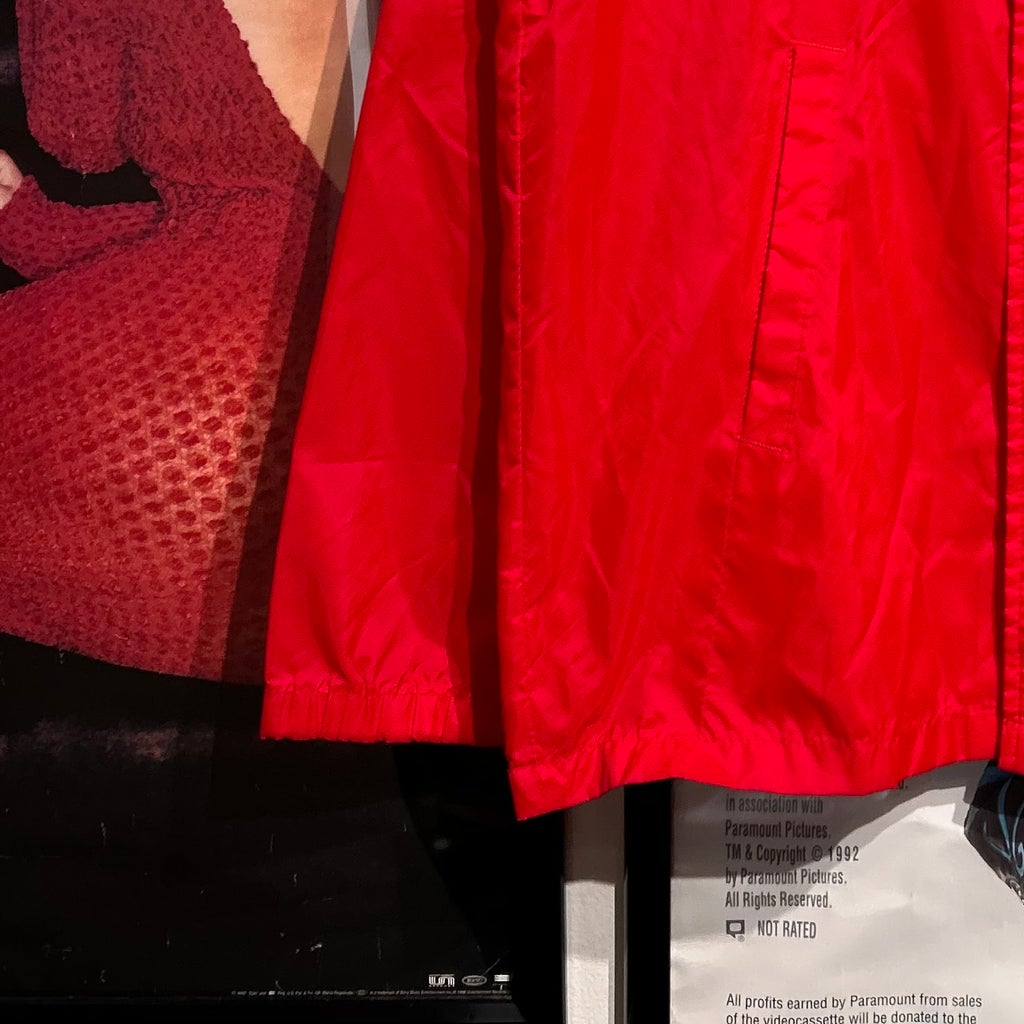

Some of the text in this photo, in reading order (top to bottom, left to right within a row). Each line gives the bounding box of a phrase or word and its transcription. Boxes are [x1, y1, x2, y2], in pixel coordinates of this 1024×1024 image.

[725, 794, 824, 814] in association with
[725, 819, 832, 839] Paramount Pictures.
[725, 843, 742, 860] TM
[745, 844, 753, 861] &
[756, 844, 806, 866] Copyright
[828, 845, 860, 861] 1992
[725, 867, 848, 888] by Paramount Pictures.
[725, 891, 833, 910] All Rights Reserved.
[757, 919, 817, 939] NOT RATED
[726, 992, 983, 1011] All profits earned by Paramount from sales
[726, 1010, 977, 1024] of the videocassette will be donated to the
